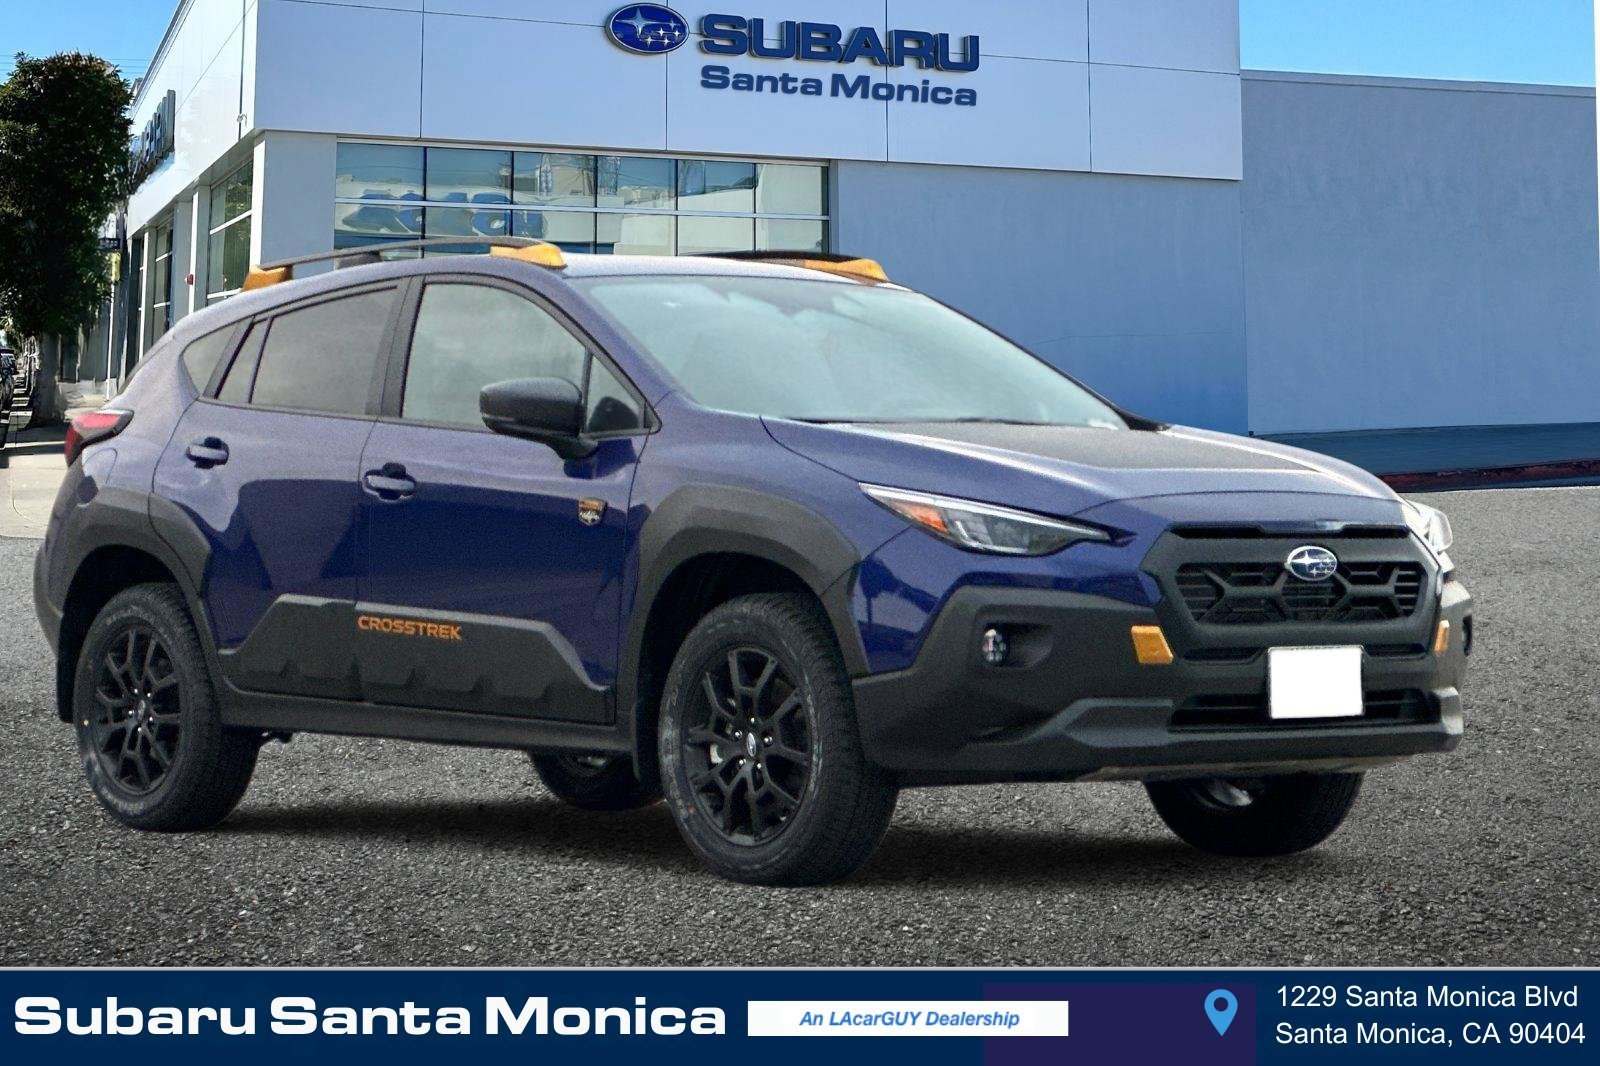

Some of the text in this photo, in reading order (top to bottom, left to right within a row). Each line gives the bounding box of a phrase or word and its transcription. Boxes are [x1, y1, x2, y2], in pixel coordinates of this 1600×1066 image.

[700, 13, 980, 72] SUBARU
[700, 65, 978, 106] Santa Monica
[357, 616, 461, 640] CROSSTREK
